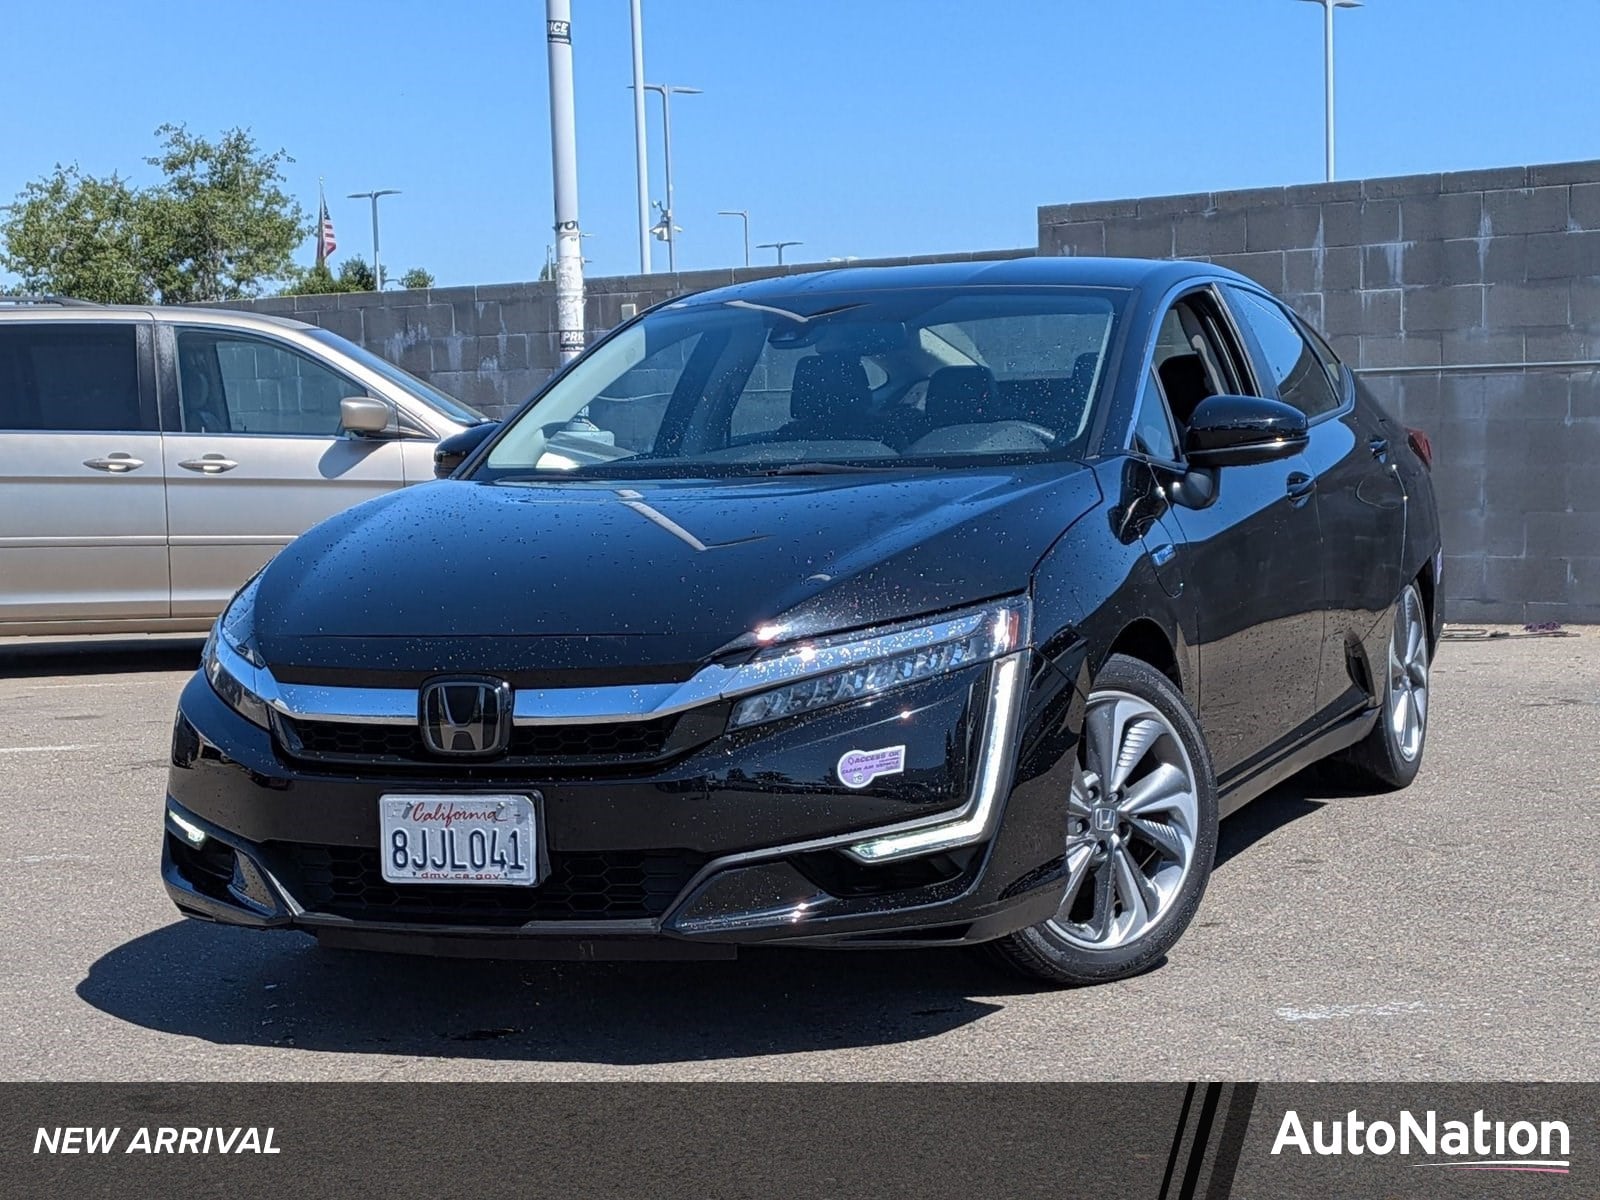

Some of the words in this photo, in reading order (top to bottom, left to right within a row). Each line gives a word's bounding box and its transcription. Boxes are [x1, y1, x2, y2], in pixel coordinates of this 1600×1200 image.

[854, 751, 886, 764] ACCESS
[412, 801, 507, 828] California
[391, 828, 525, 871] 8JJL041
[421, 872, 501, 881] dmv.ca.gov
